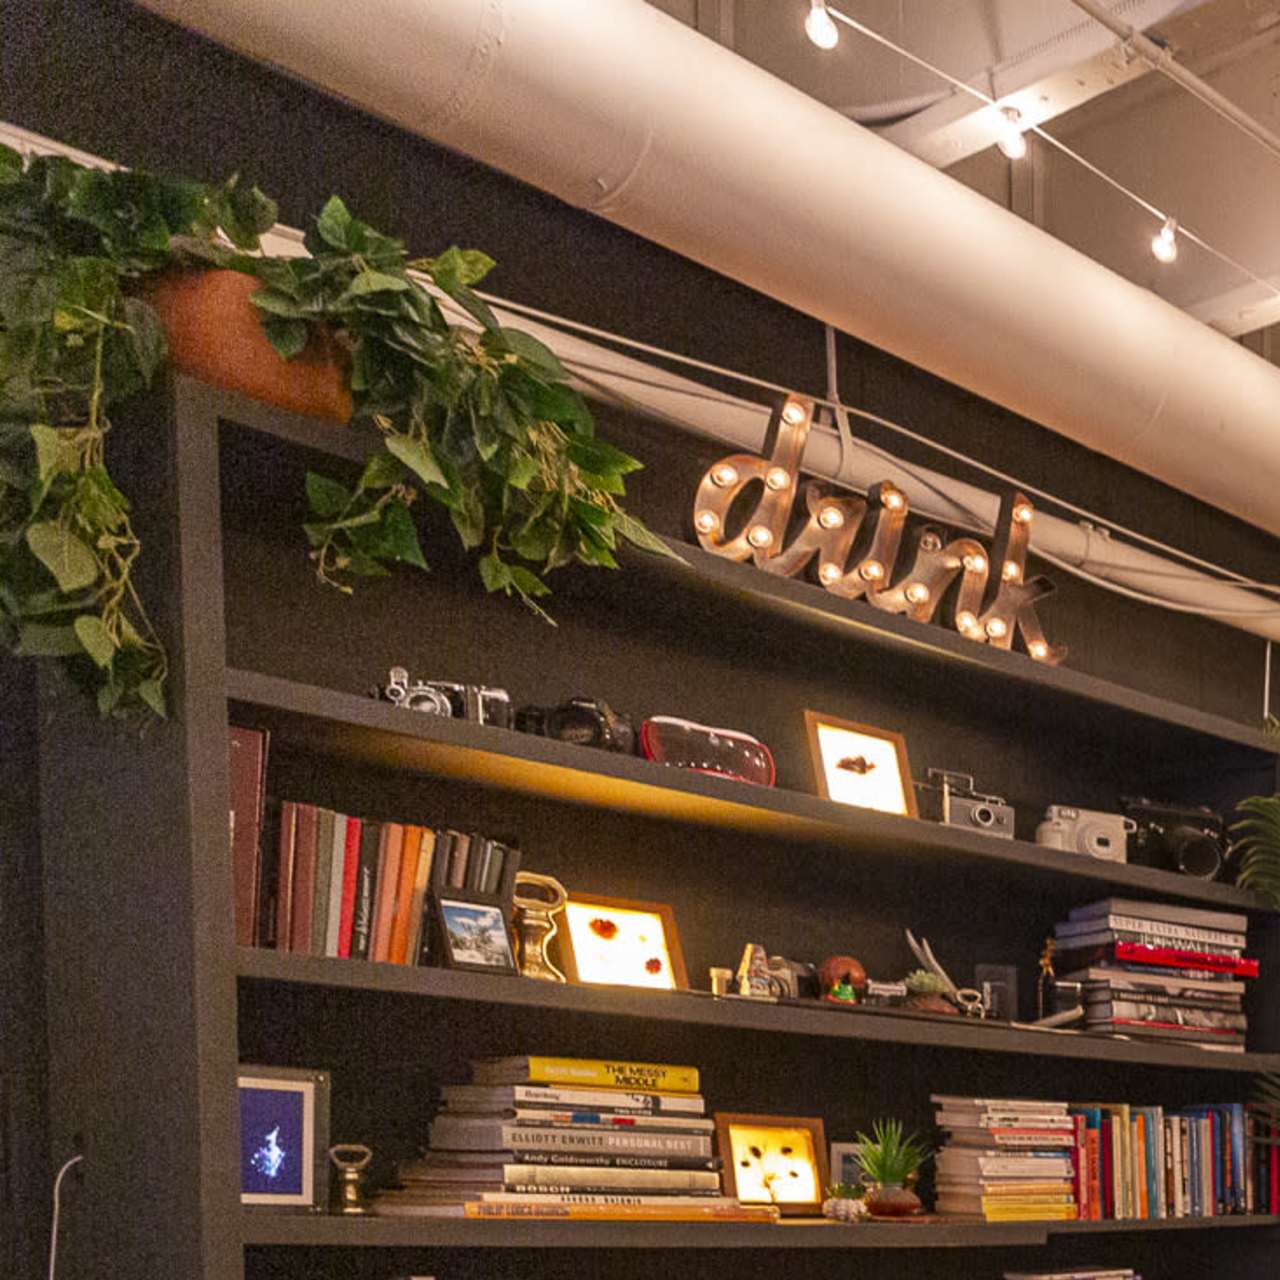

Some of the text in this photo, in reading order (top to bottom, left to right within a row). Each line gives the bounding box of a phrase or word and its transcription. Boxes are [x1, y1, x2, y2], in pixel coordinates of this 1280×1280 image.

[694, 393, 1068, 666] drink
[604, 1063, 624, 1075] THE
[628, 1065, 668, 1079] MESSY
[615, 1075, 657, 1088] MIDDLE
[511, 1132, 693, 1151] ELLIOTT ERWITT PERSONAL BEST
[524, 1152, 548, 1165] Andy
